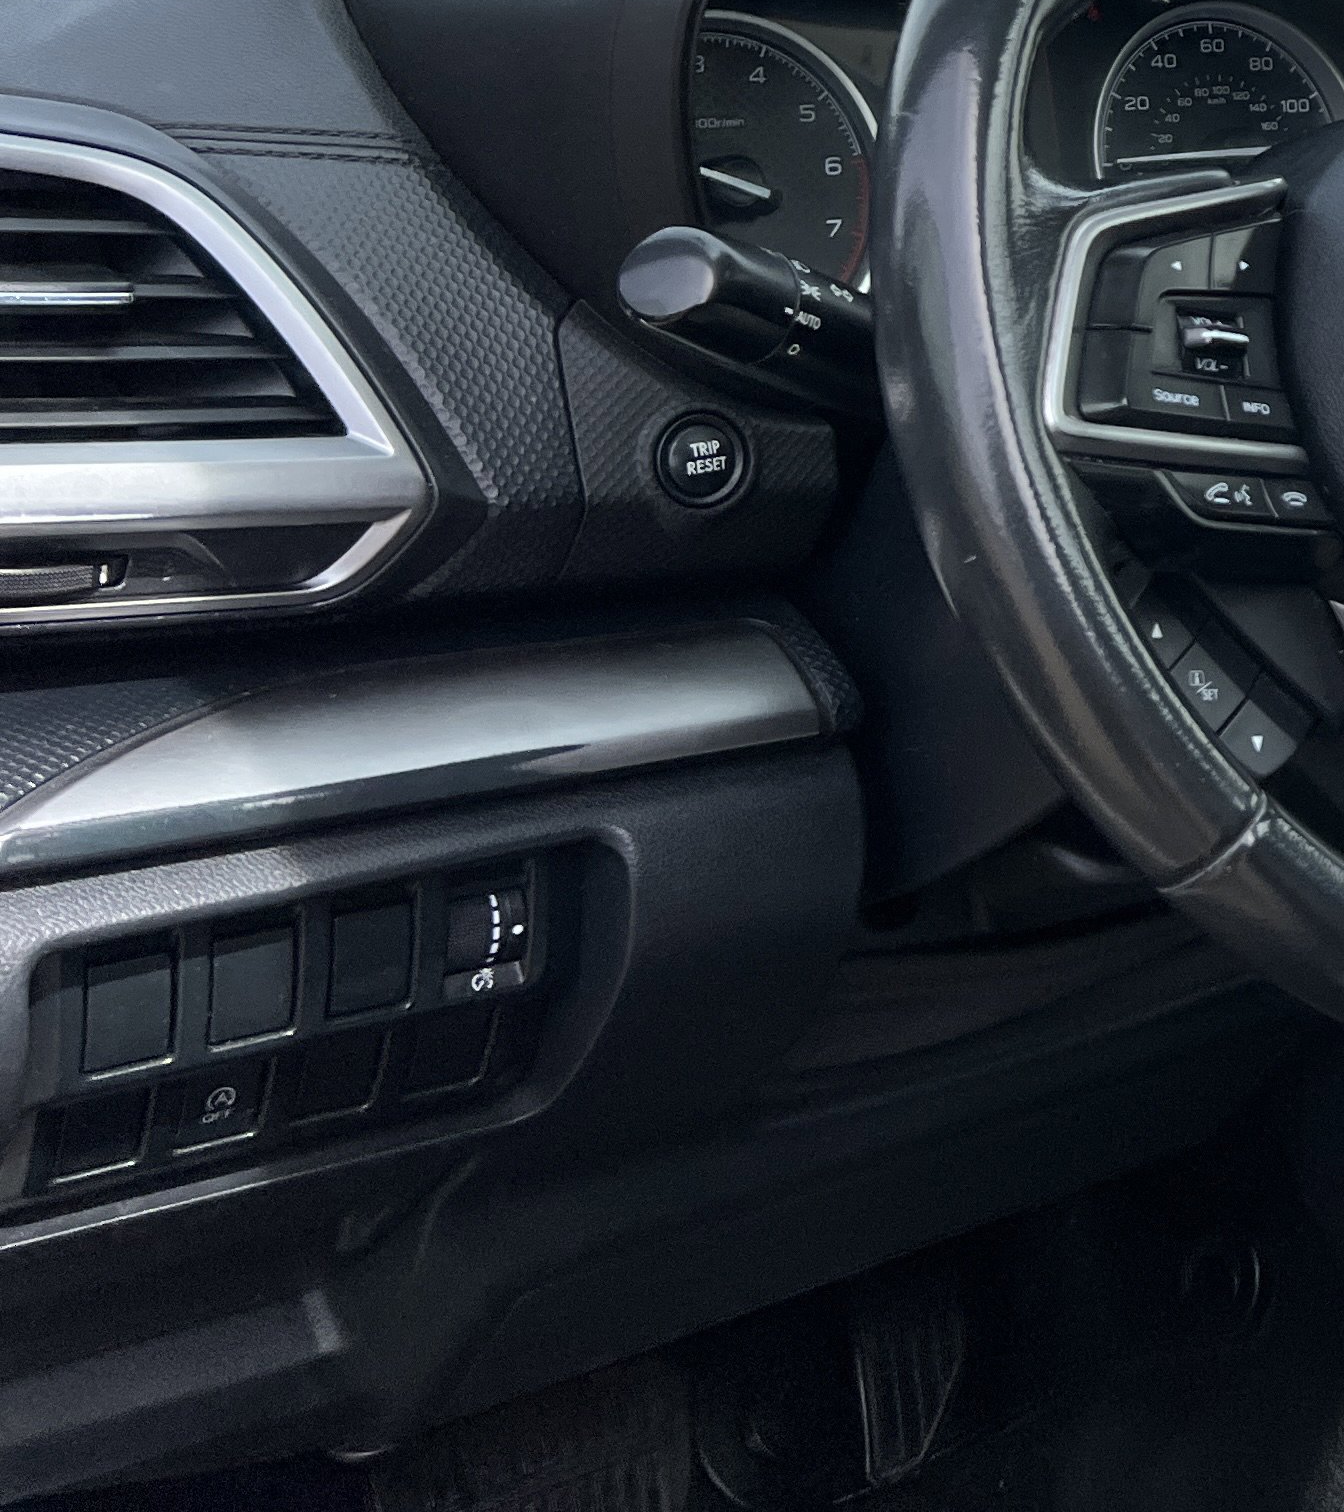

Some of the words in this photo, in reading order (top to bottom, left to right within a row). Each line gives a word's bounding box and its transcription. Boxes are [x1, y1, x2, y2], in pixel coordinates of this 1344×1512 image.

[1200, 38, 1224, 53] 60
[1150, 53, 1177, 68] 40
[1249, 56, 1274, 71] 80
[749, 66, 767, 84] 4
[1213, 86, 1231, 95] 100
[1232, 91, 1250, 101] 120
[1124, 95, 1150, 111] 20
[1177, 97, 1193, 106] 60
[1249, 103, 1267, 112] 140
[1280, 99, 1310, 113] 100
[799, 103, 816, 123] 5
[1164, 113, 1181, 123] 40
[1157, 134, 1173, 143] 20
[824, 156, 842, 176] 6
[825, 218, 842, 237] 7
[795, 310, 821, 330] AUTO
[1152, 388, 1200, 406] Source
[1242, 400, 1271, 415] INFO
[689, 440, 720, 457] TRIP
[686, 455, 727, 476] RESET
